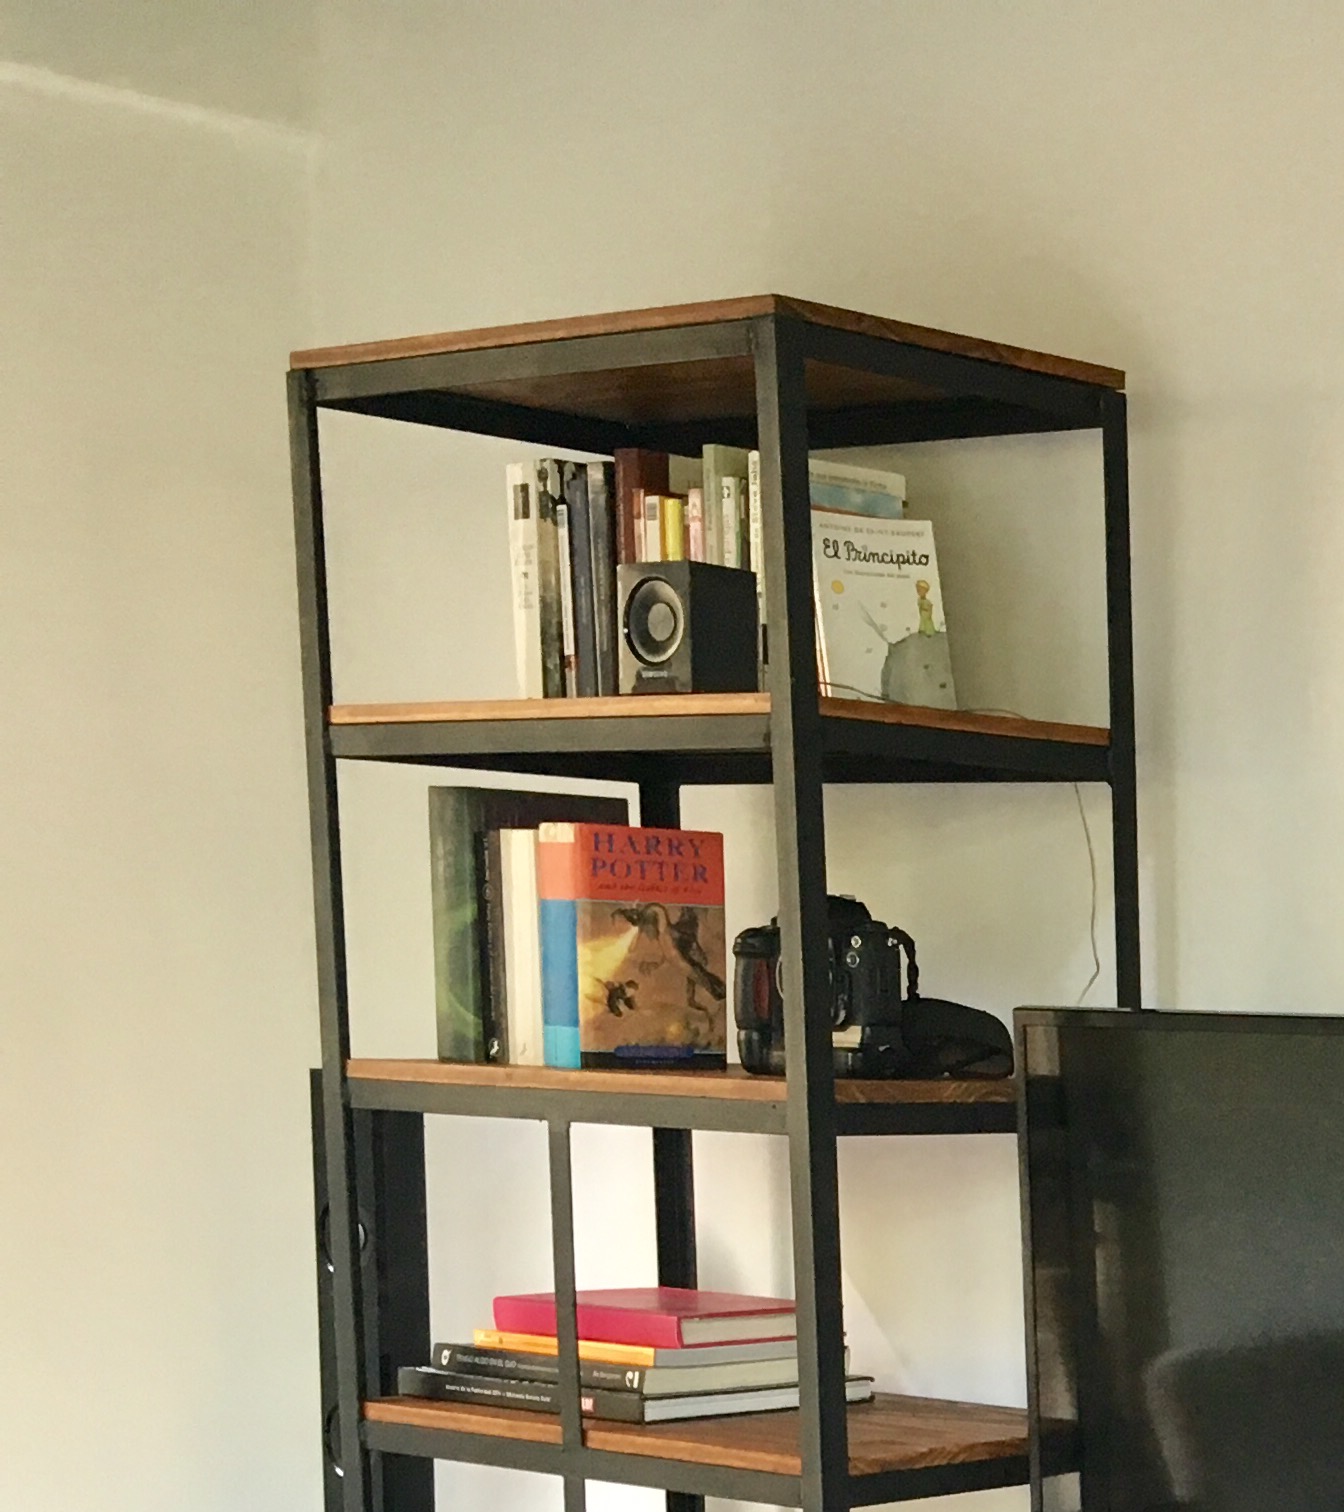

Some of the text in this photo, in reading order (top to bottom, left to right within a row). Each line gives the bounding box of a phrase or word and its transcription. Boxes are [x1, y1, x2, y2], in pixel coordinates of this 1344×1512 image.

[822, 537, 930, 570] El Principito
[592, 831, 704, 858] HARRY
[590, 857, 709, 884] POTTER
